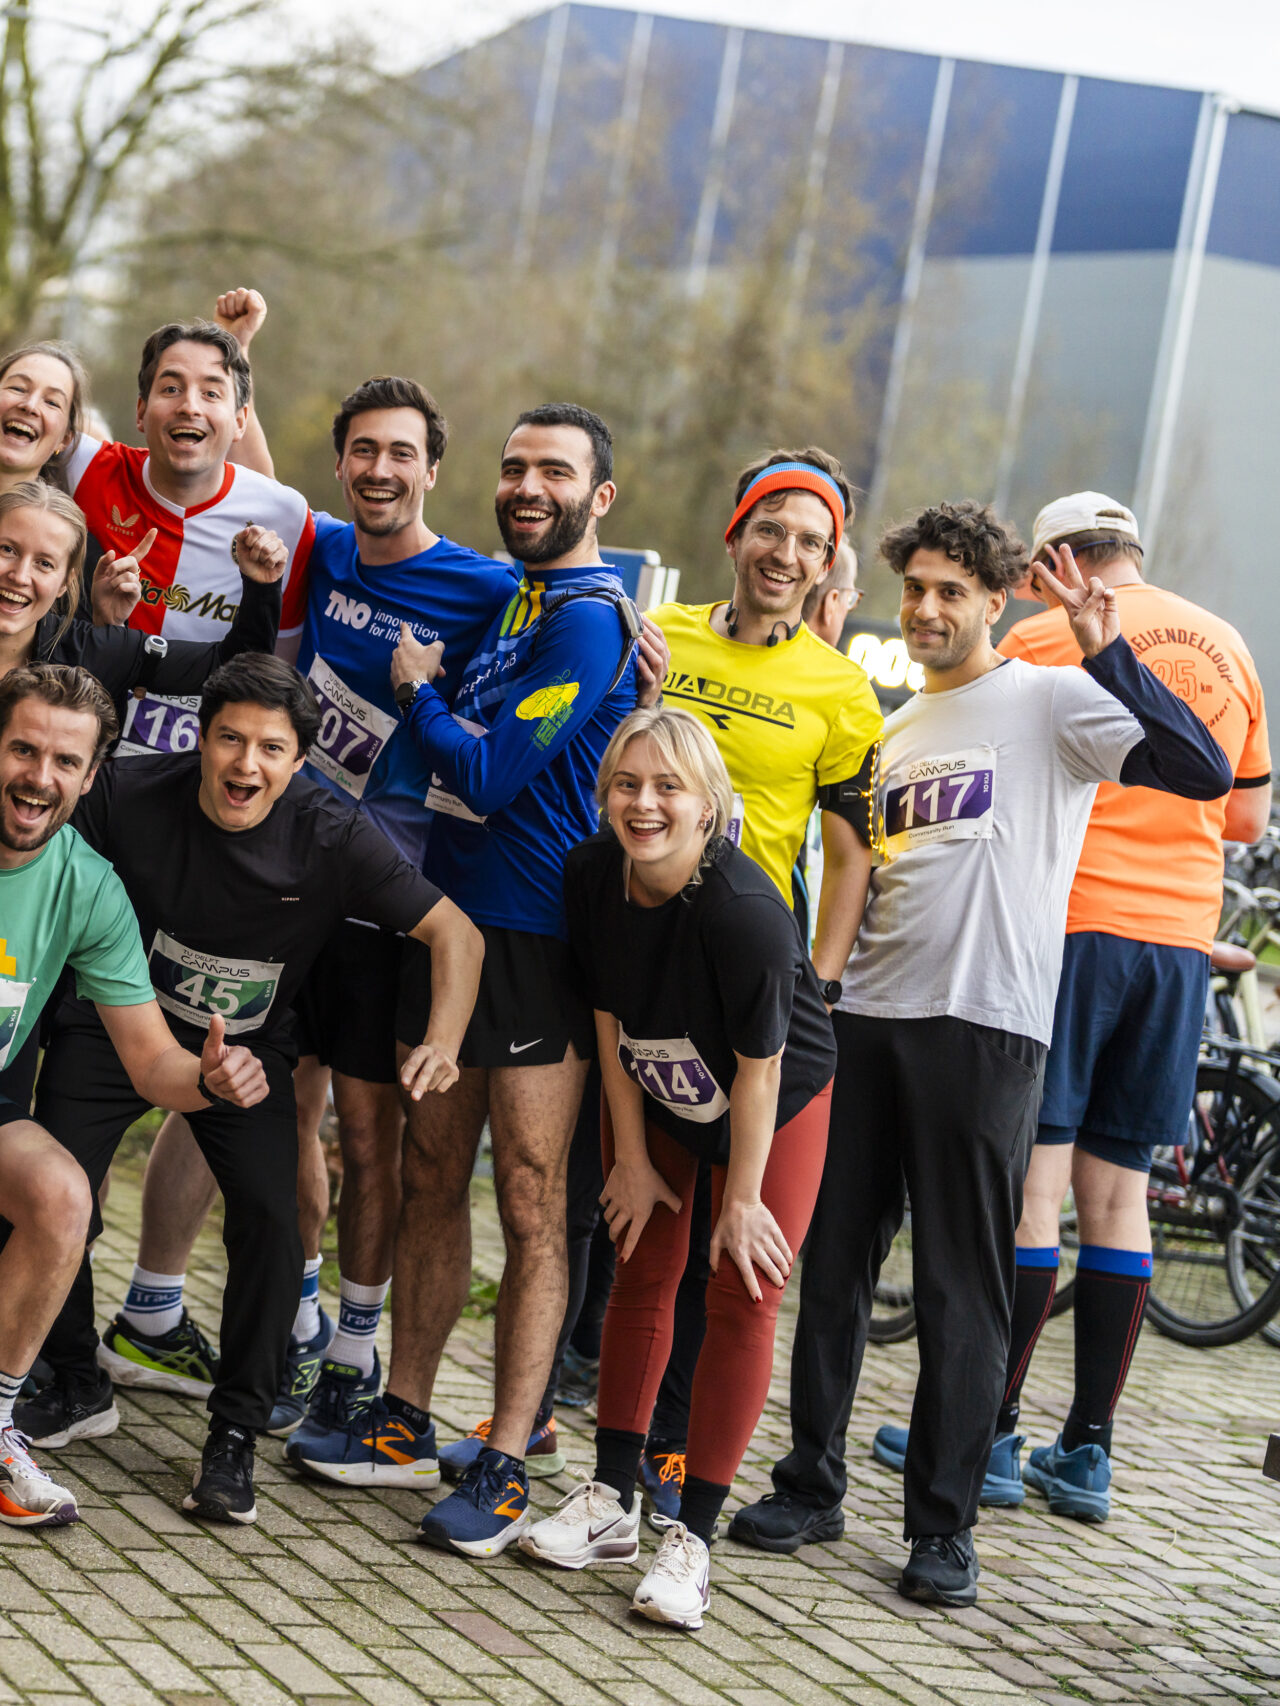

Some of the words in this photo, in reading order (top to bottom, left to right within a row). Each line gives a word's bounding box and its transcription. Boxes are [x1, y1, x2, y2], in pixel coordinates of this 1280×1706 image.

[324, 590, 372, 630] TNO
[369, 623, 385, 637] for
[1201, 682, 1213, 694] km
[908, 760, 966, 780] CAMPUS
[899, 774, 975, 828] 117
[181, 955, 250, 977] CAMPUS
[174, 973, 243, 1015] 45
